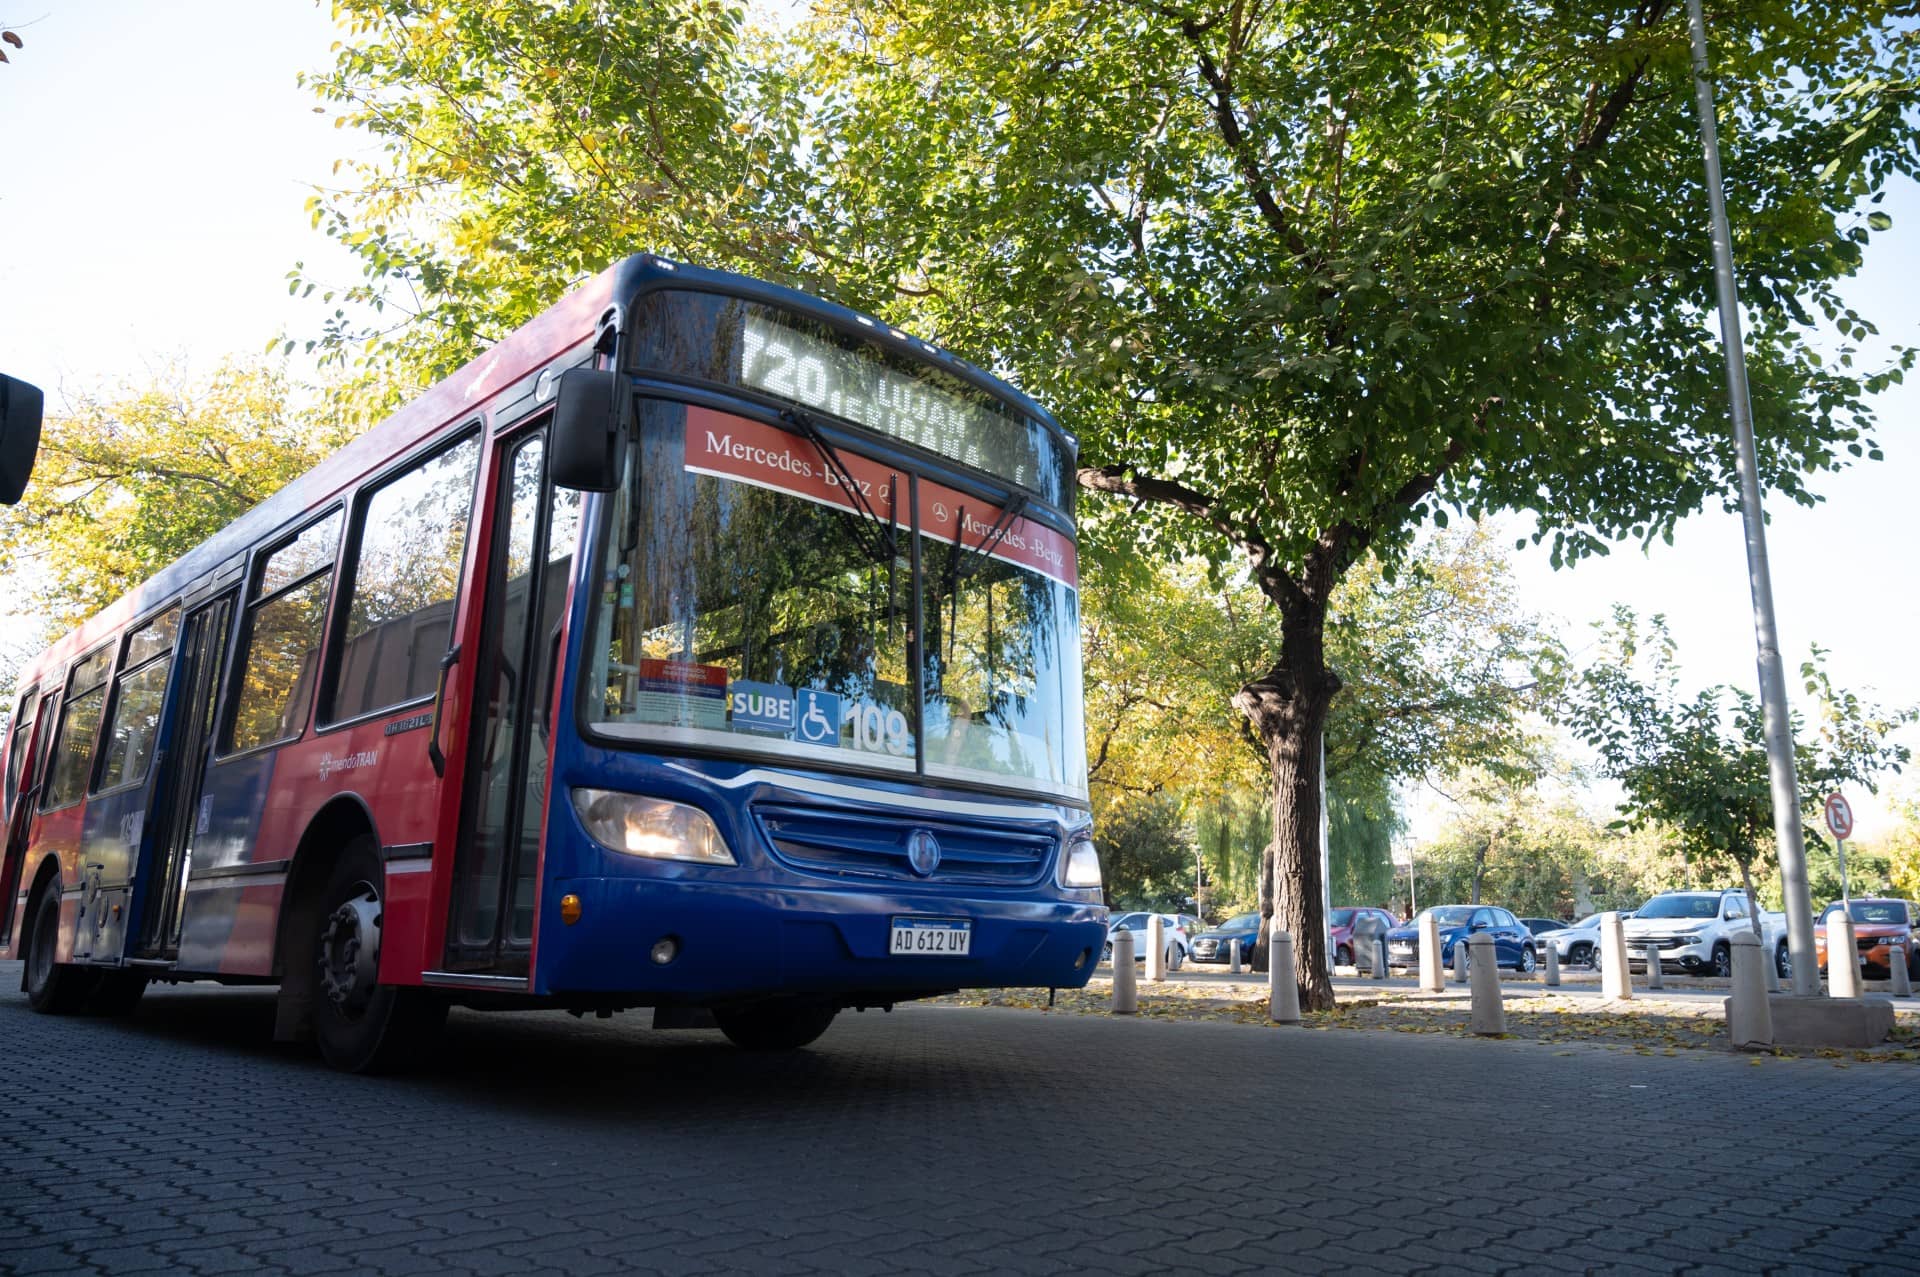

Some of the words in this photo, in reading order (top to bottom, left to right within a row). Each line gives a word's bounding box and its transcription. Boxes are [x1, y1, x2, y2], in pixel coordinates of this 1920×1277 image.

[742, 329, 827, 406] 720
[733, 692, 791, 721] SUBE
[845, 703, 909, 756] 109
[895, 930, 913, 951] AD
[917, 930, 944, 952] 612
[948, 931, 967, 952] UY
